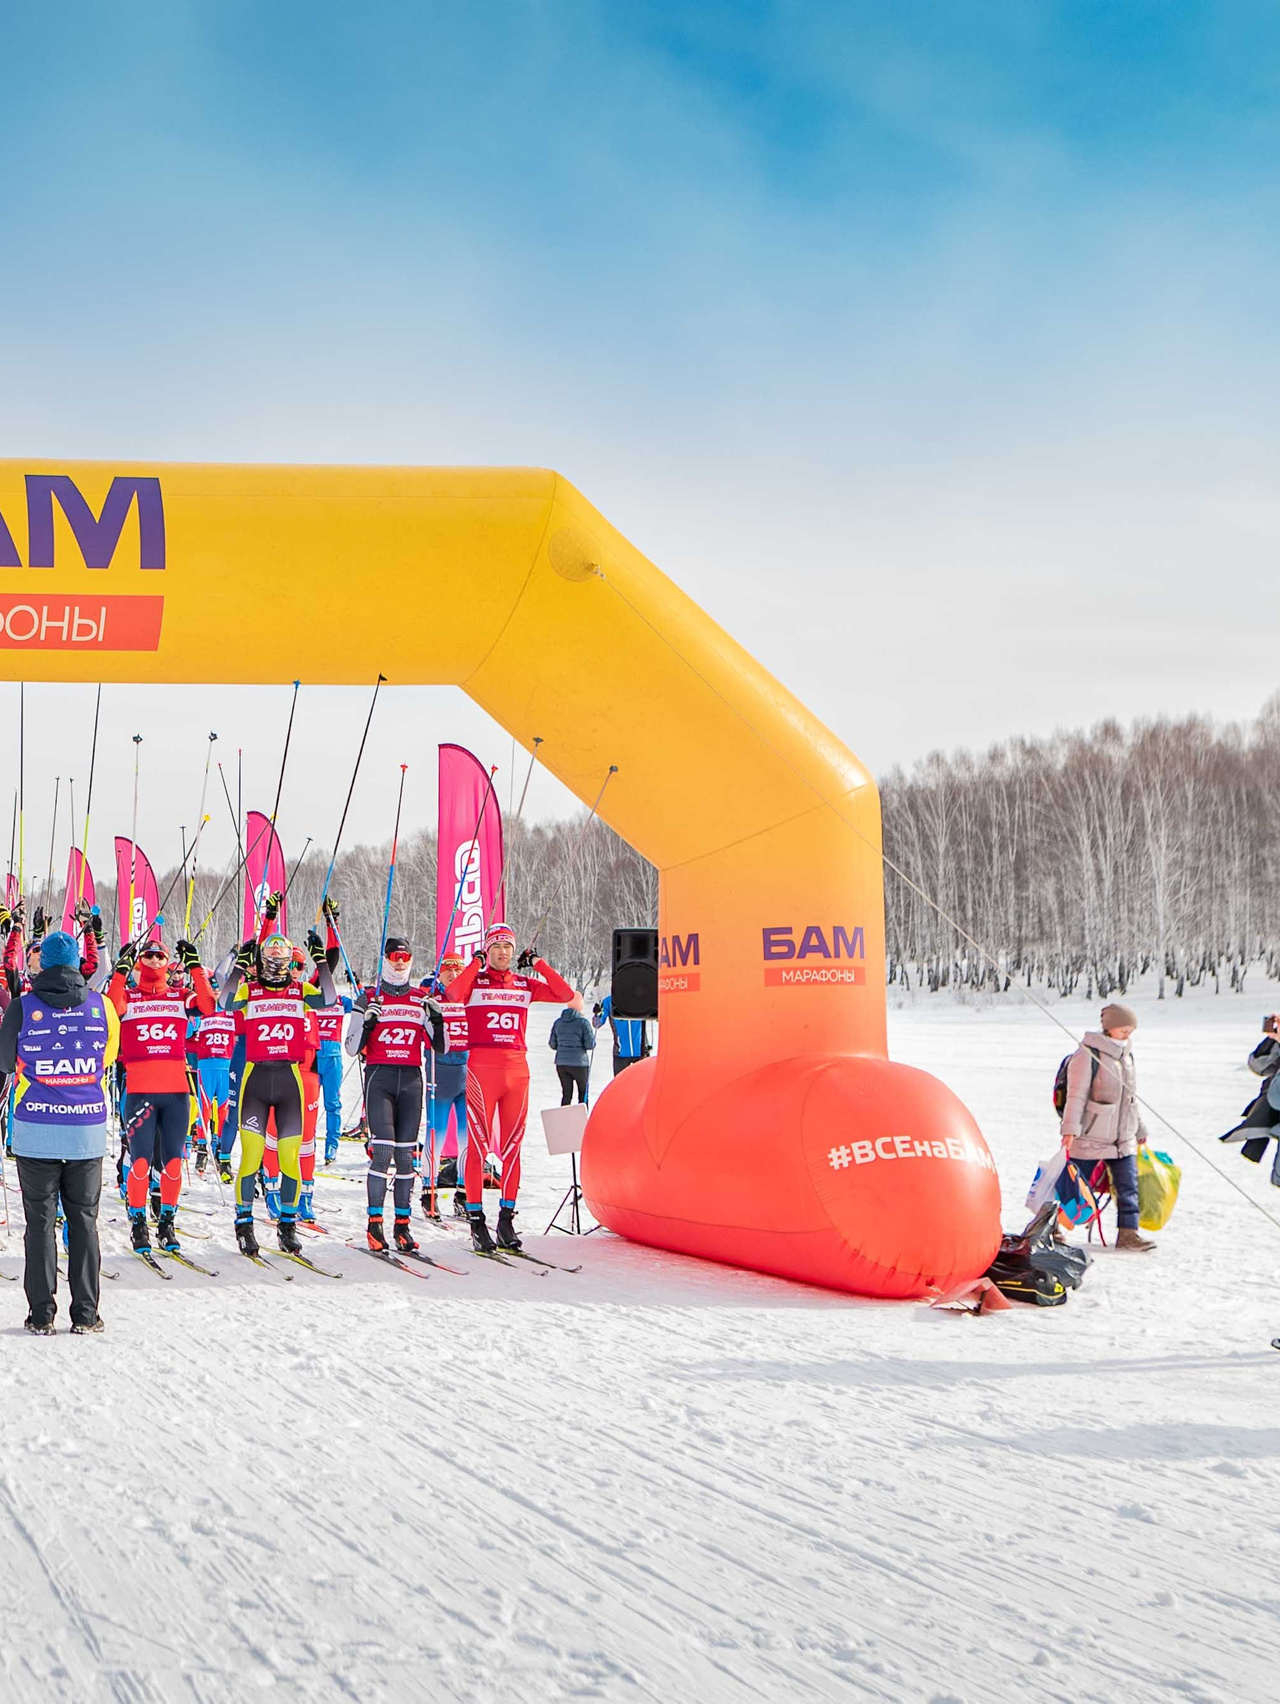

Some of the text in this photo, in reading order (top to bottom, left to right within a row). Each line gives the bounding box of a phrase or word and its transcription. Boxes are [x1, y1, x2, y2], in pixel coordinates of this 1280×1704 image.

[659, 933, 700, 969] АМ
[762, 925, 865, 961] БАМ
[782, 969, 855, 983] МАРАФОНЫ
[380, 1009, 421, 1018] ЕМЕРСО
[486, 1012, 520, 1030] 261
[136, 1023, 178, 1041] 364
[205, 1033, 229, 1046] 283
[257, 1023, 294, 1041] 240
[378, 1028, 416, 1045] 427
[35, 1058, 96, 1075] БАМ
[45, 1077, 88, 1085] МАРАФОНЫ
[25, 1102, 104, 1115] ОРГКОМИТЕТ
[827, 1135, 996, 1174] #ВСЕнаБАМ
